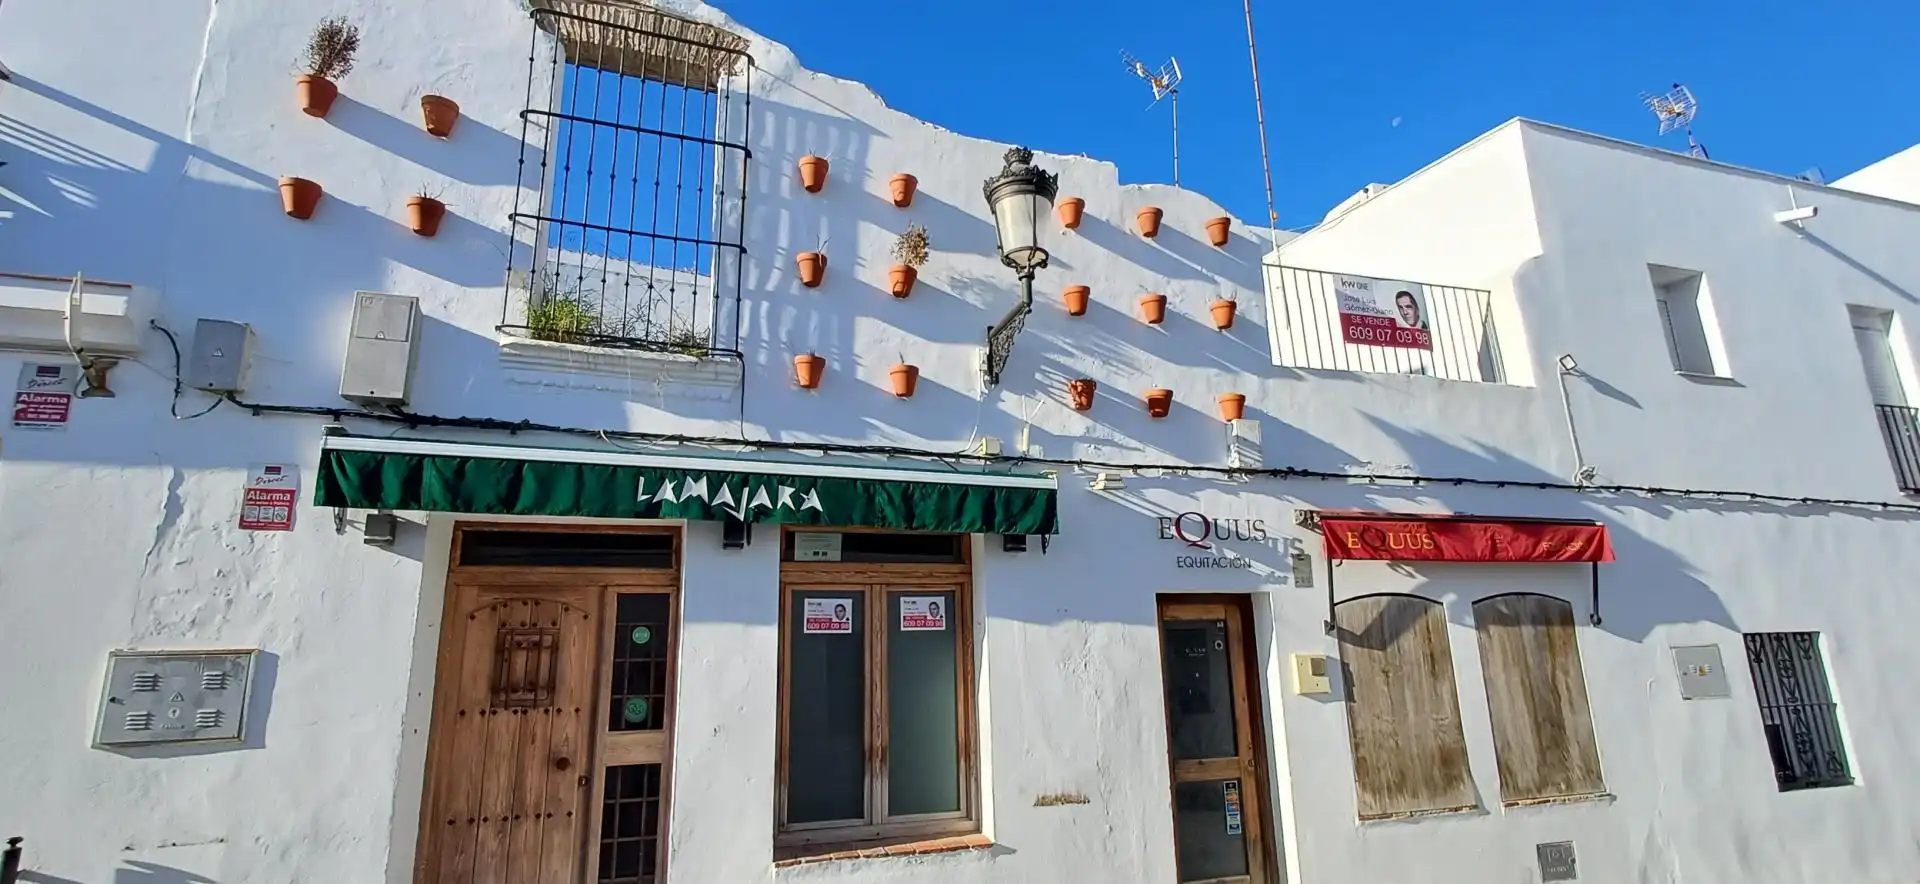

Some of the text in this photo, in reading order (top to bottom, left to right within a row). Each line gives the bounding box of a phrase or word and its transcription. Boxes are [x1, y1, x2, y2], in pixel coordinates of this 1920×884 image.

[1350, 315, 1392, 326] SE VENDE
[1349, 326, 1430, 345] 609 07 09 98
[18, 393, 68, 403] Alarma
[247, 490, 291, 500] Alarma
[1176, 554, 1252, 568] EQUITACIÓN
